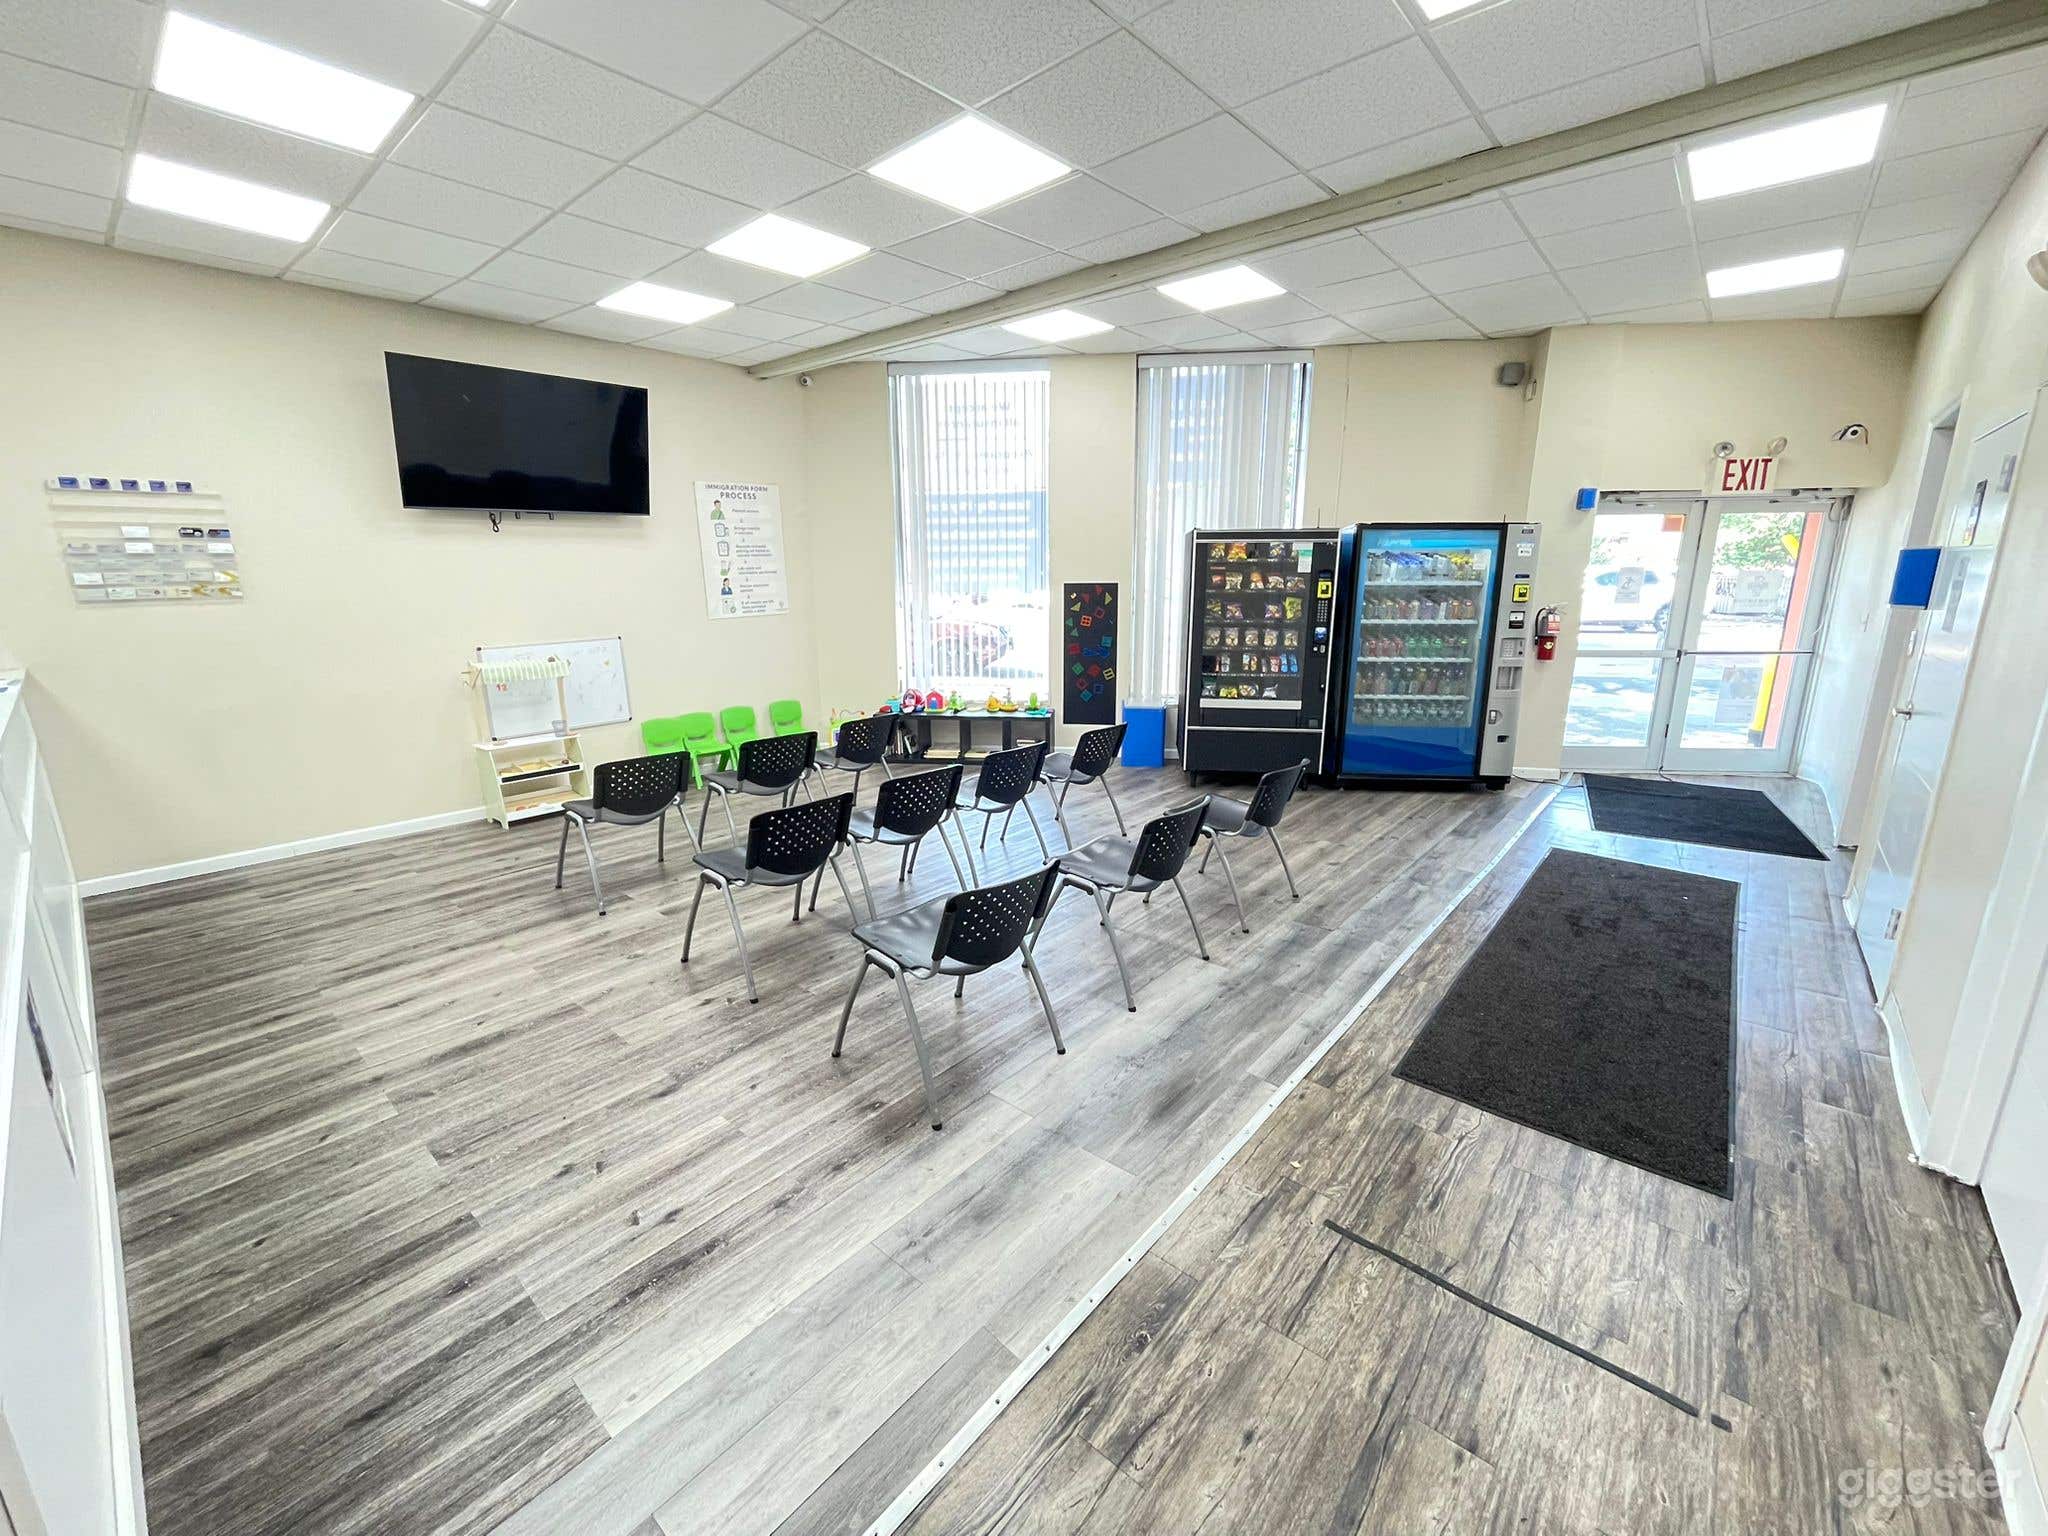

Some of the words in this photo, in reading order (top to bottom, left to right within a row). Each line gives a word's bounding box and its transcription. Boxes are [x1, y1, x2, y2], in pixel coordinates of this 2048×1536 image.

[1721, 458, 1773, 491] EXIT
[704, 483, 750, 491] IMMIGRATION
[720, 491, 757, 500] PROCESS
